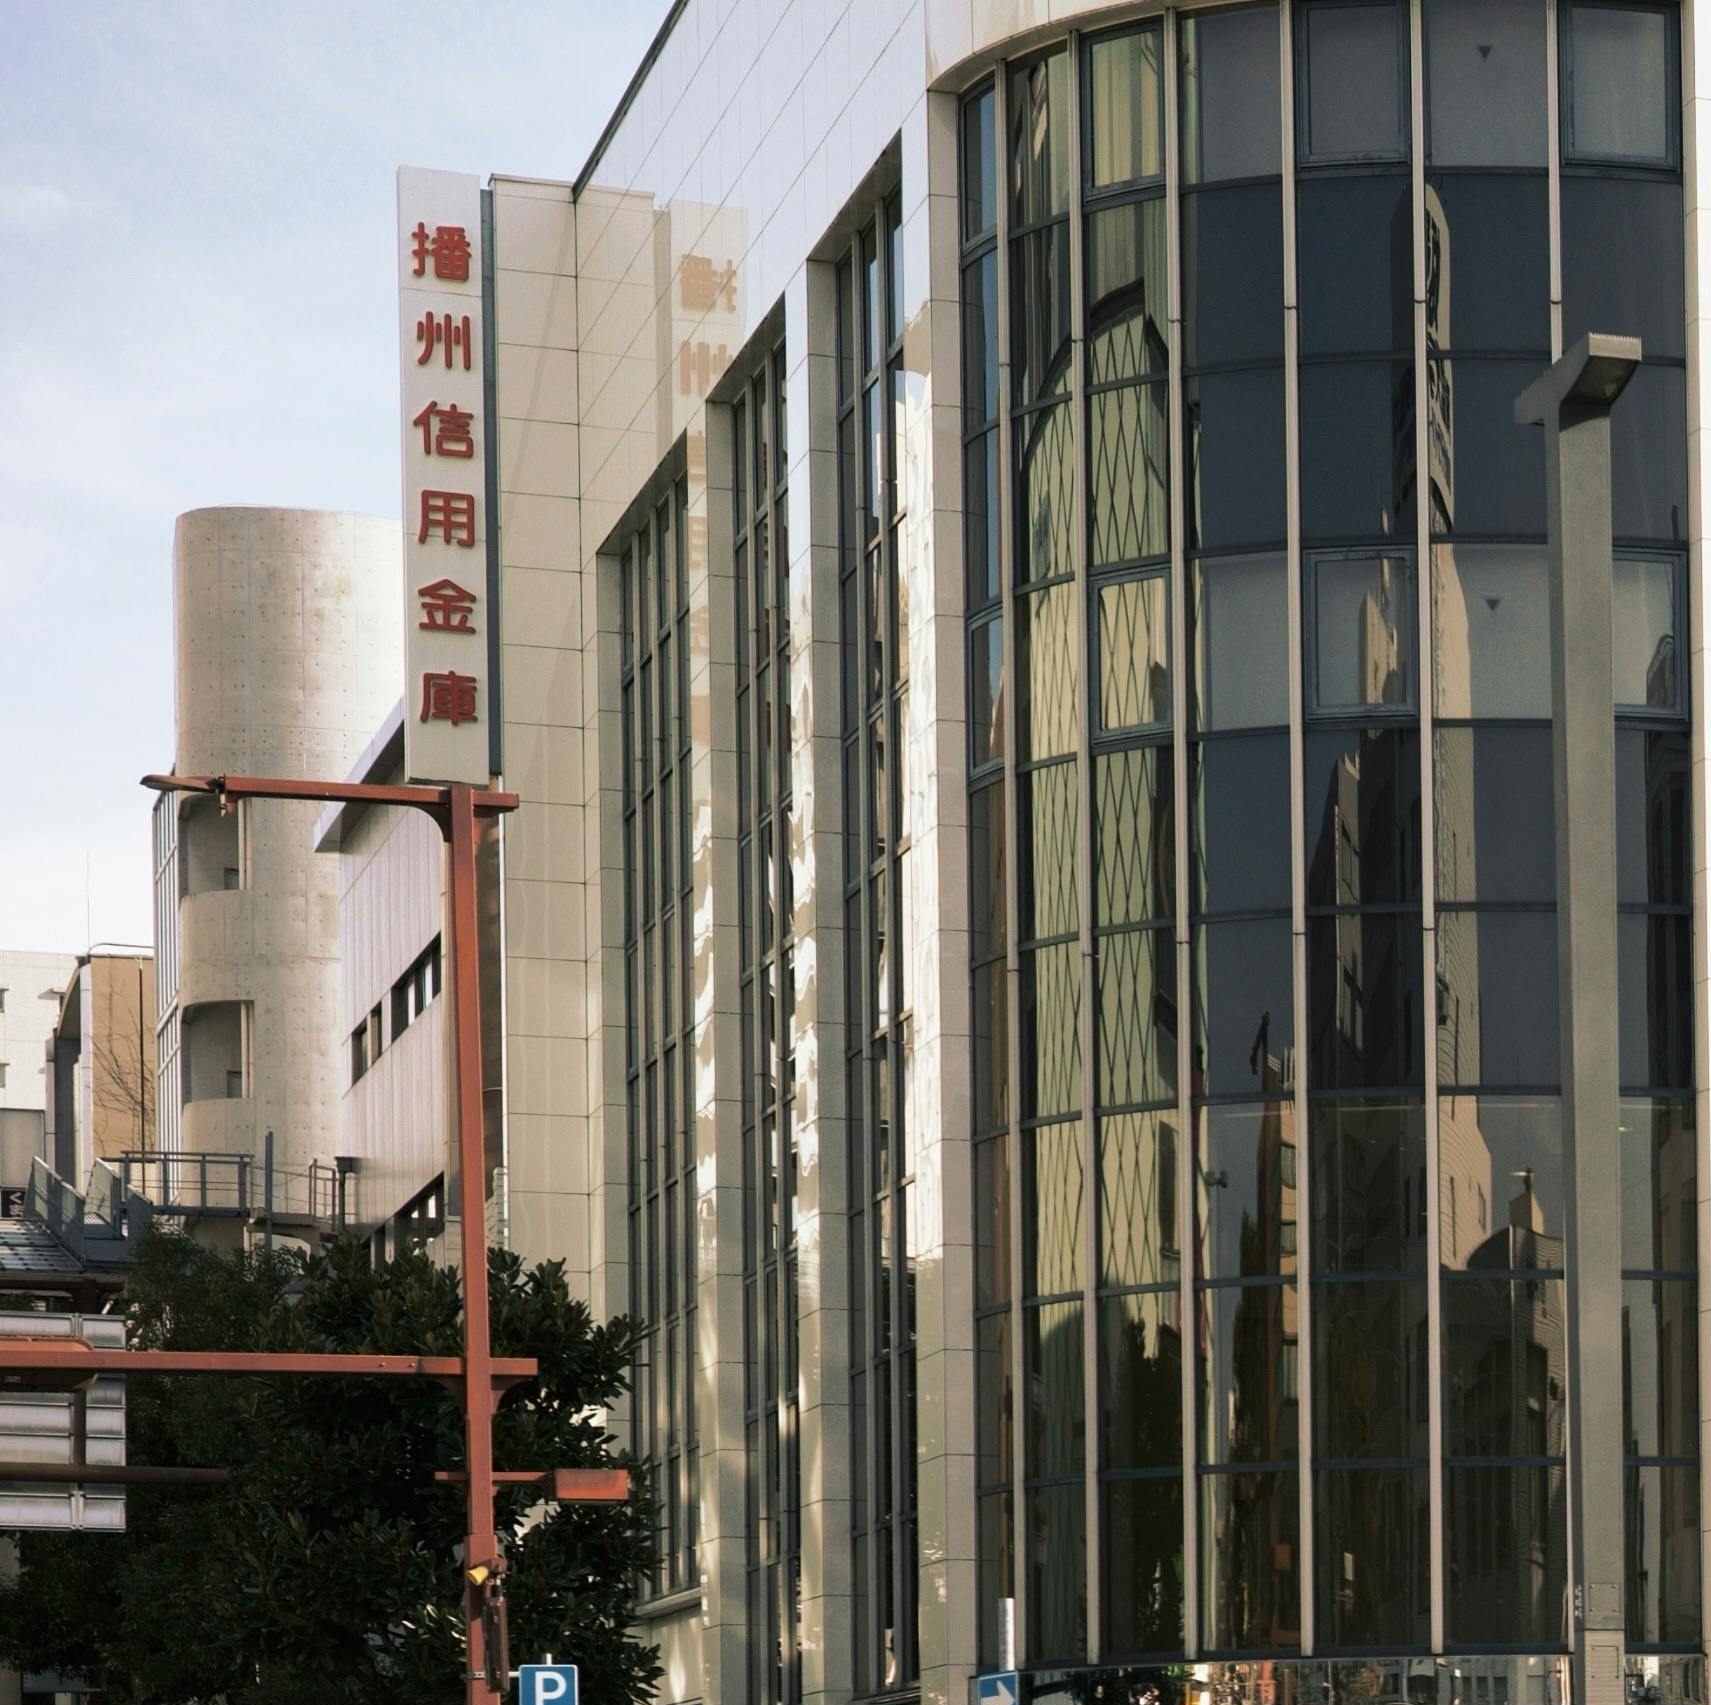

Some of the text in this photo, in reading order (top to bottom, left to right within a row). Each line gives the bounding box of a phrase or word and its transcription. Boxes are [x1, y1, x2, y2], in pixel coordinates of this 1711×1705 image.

[411, 222, 479, 726] 播州信用金庫
